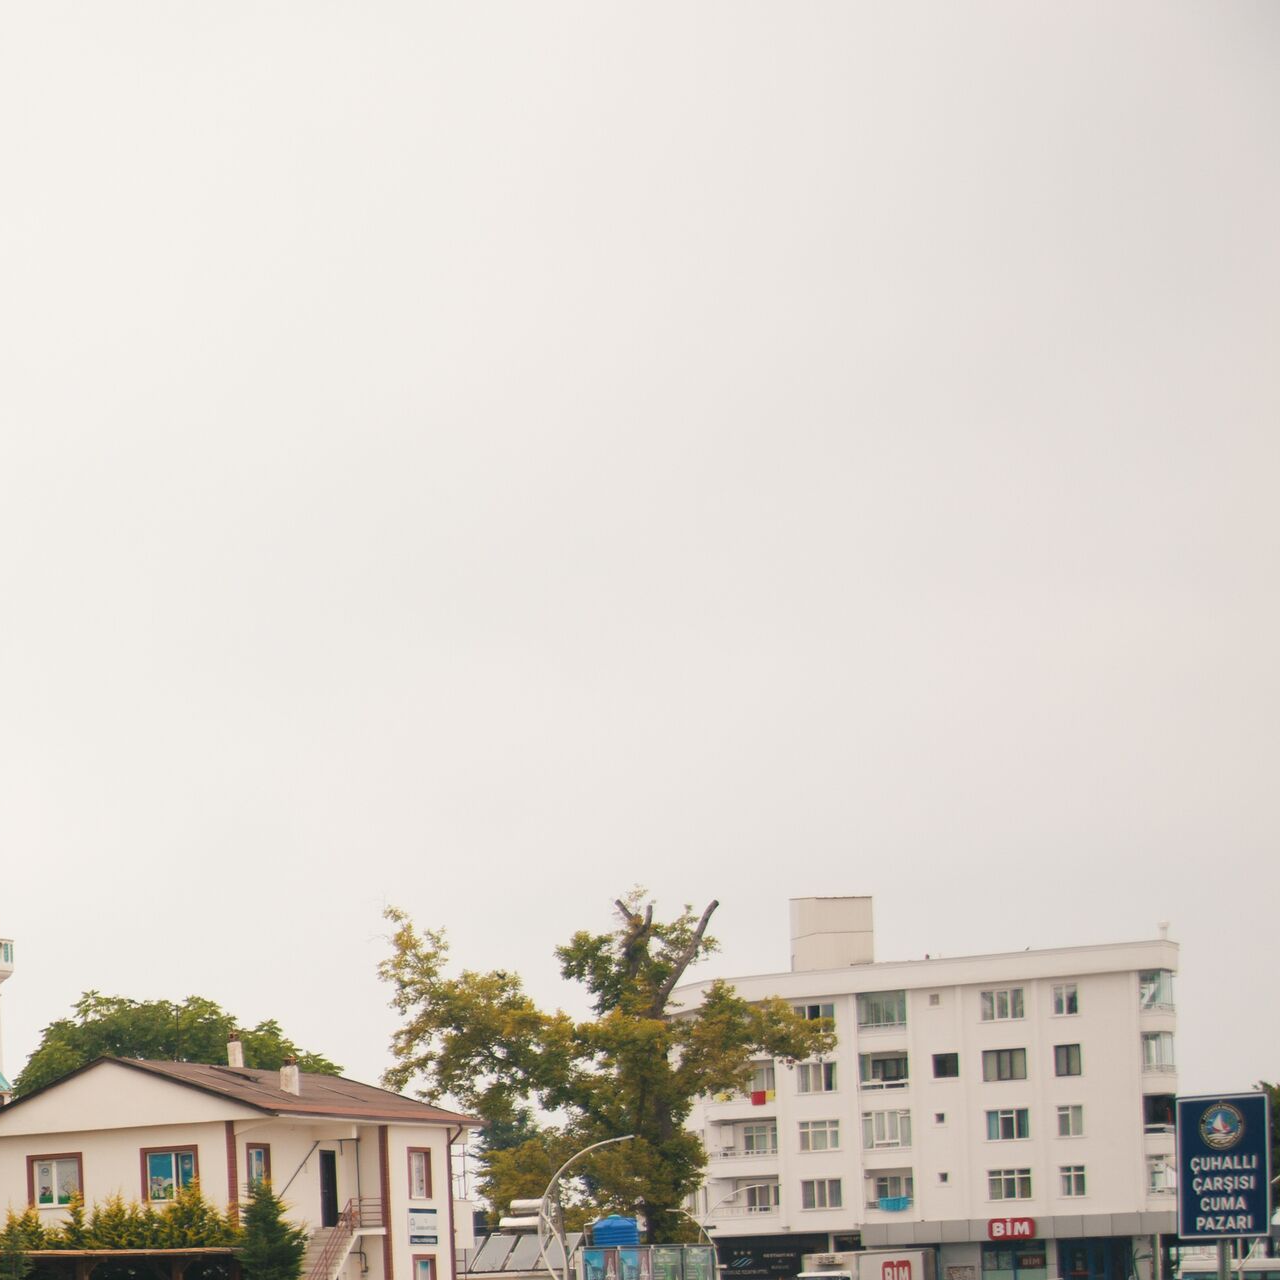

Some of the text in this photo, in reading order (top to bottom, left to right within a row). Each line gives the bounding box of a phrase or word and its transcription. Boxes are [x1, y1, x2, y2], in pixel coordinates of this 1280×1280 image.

[1190, 1155, 1257, 1174] ÇUHALLI
[1192, 1176, 1255, 1195] ÇARŞISI
[1200, 1197, 1247, 1211] CUMA
[992, 1219, 1030, 1236] BİM
[1196, 1215, 1253, 1231] PAZARI
